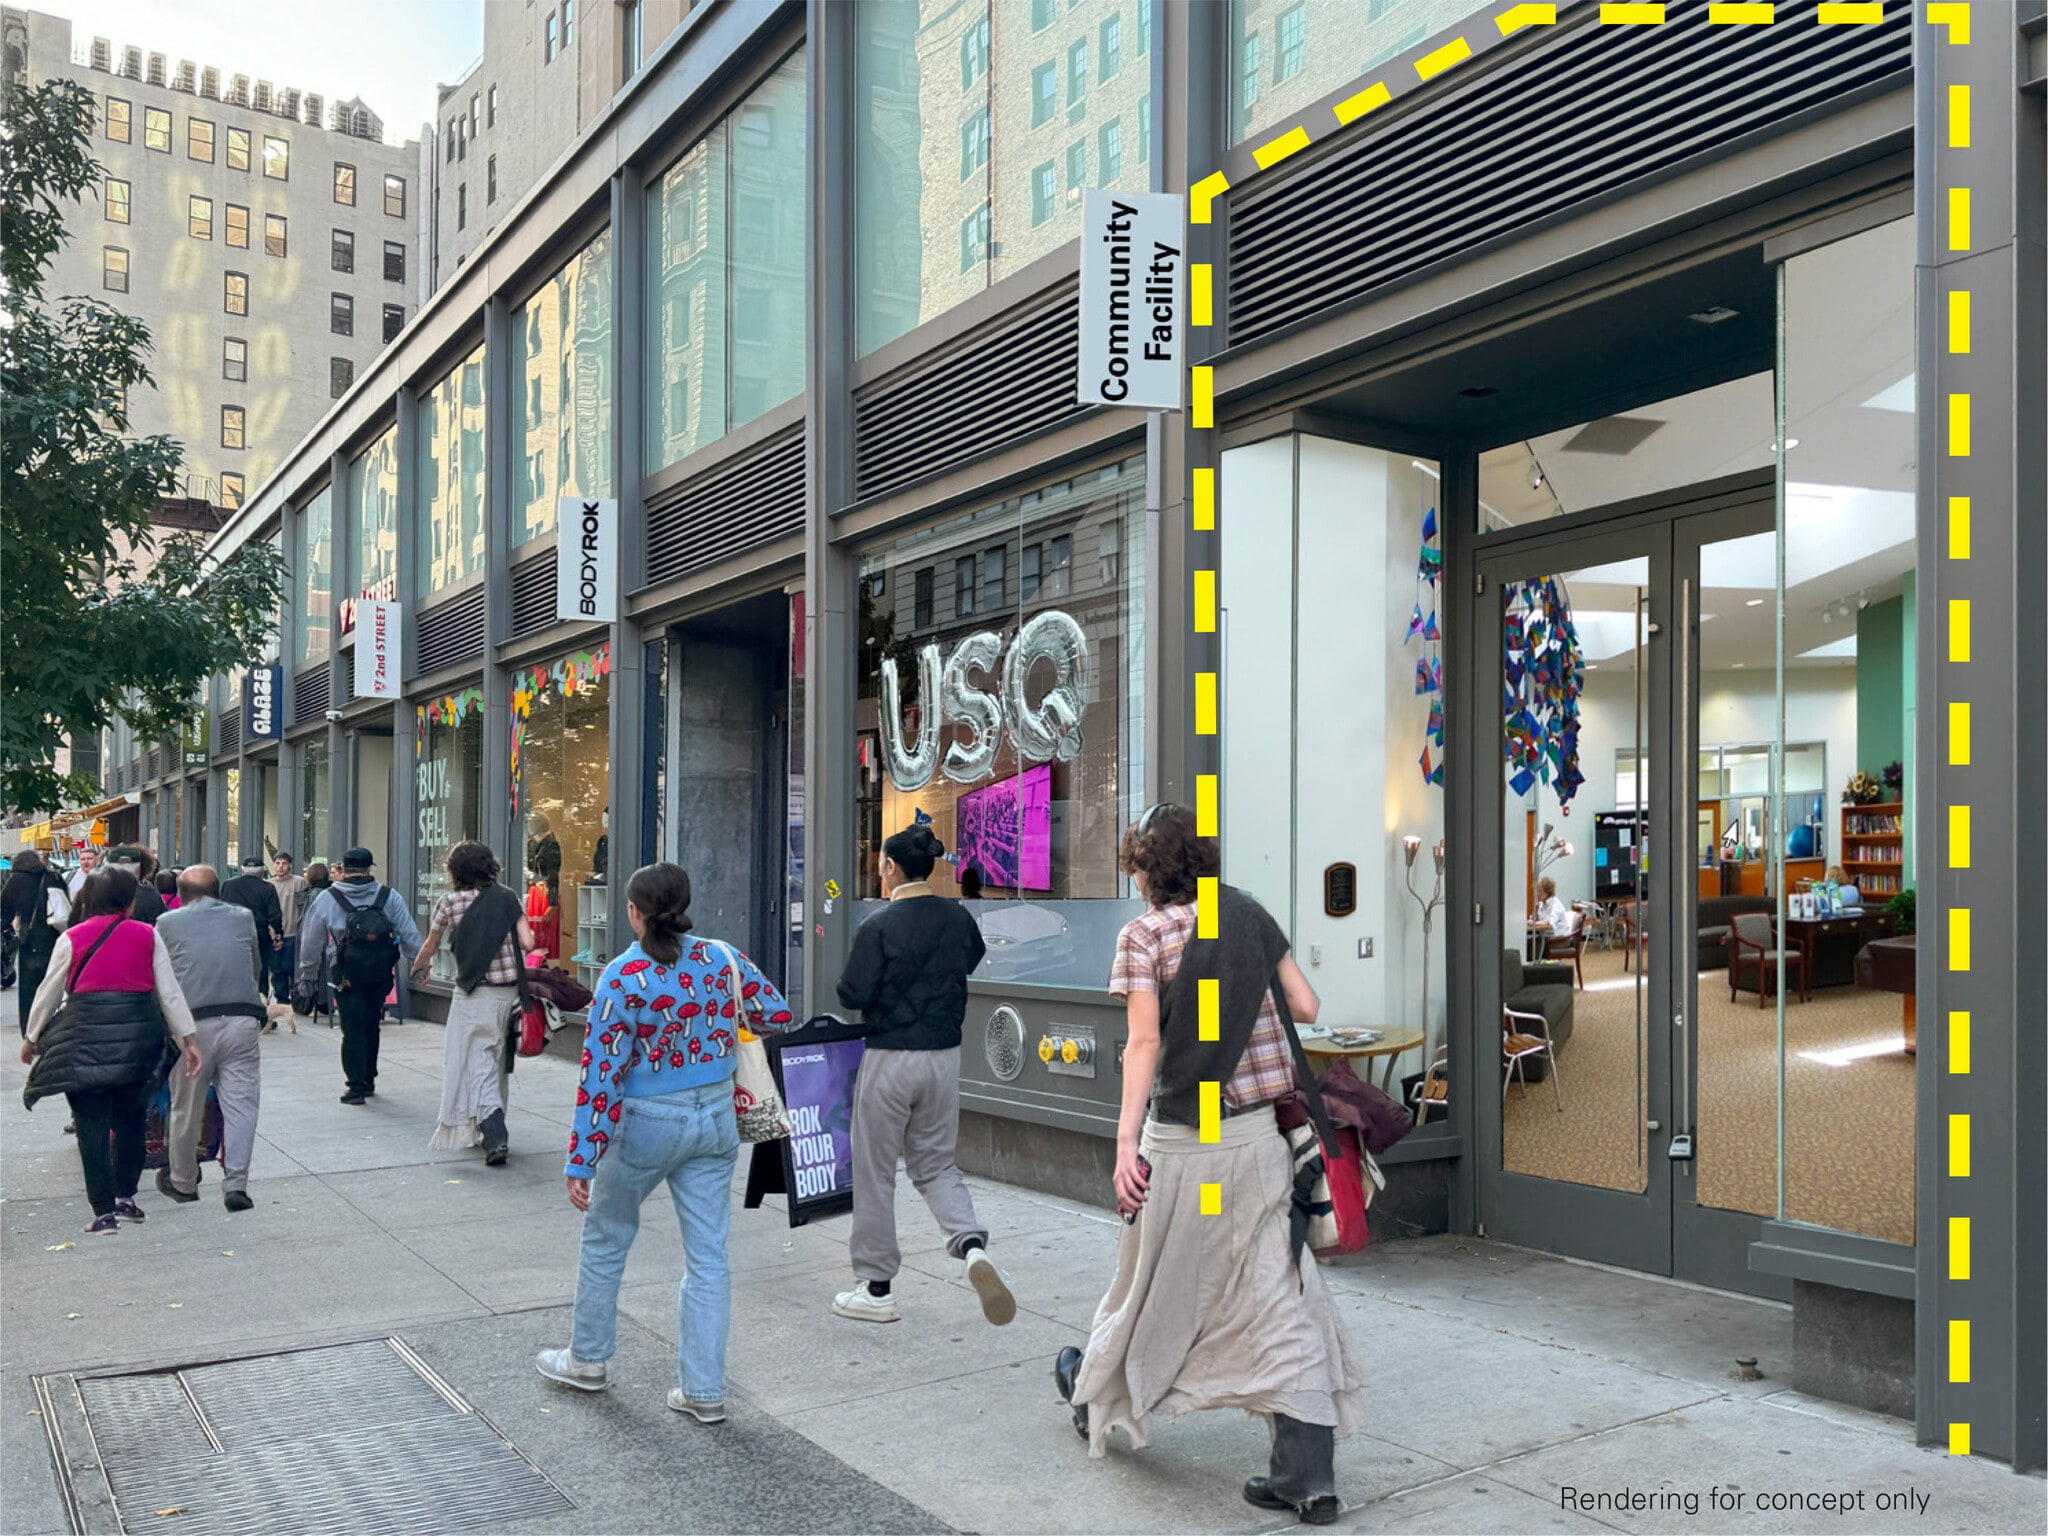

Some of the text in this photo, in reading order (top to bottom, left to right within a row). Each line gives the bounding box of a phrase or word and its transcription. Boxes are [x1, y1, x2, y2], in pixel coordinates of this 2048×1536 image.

[1100, 200, 1138, 402] Community
[1144, 241, 1180, 361] Facility
[580, 501, 599, 616] BODYROK
[375, 606, 385, 678] 2nd STREET
[253, 668, 272, 735] GLAZE
[879, 611, 1091, 793] USQ
[419, 758, 447, 802] BUY
[419, 806, 449, 848] SELL
[783, 1054, 825, 1066] BODYROK
[789, 1105, 822, 1137] ROK
[791, 1133, 836, 1167] YOUR
[795, 1163, 837, 1199] BODY
